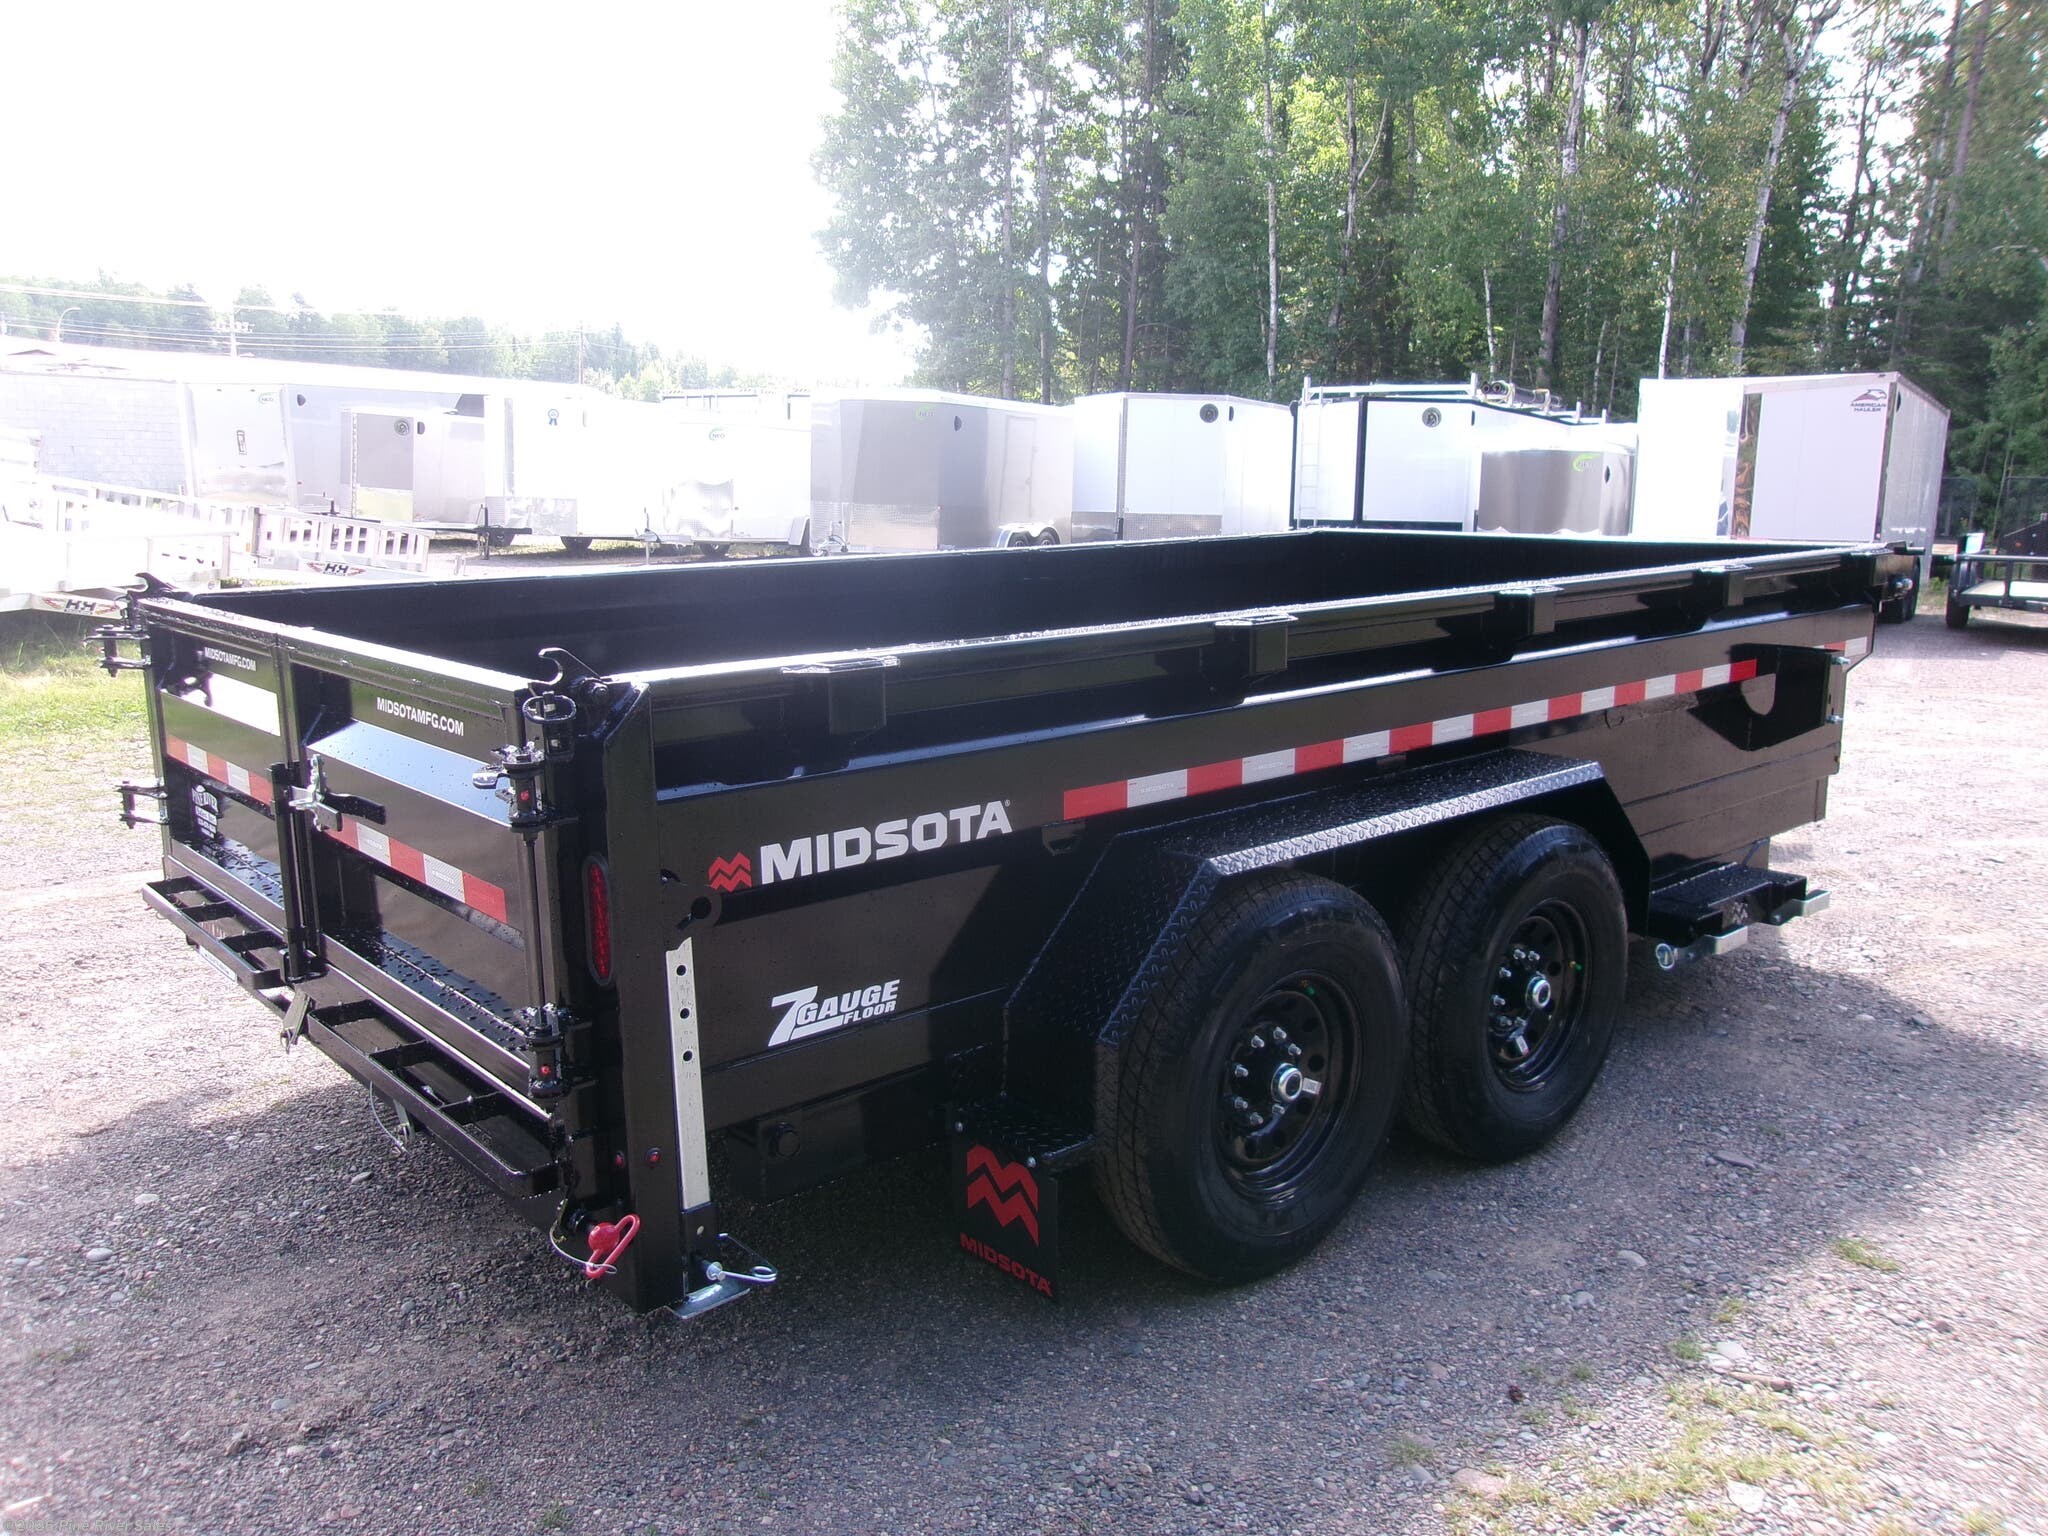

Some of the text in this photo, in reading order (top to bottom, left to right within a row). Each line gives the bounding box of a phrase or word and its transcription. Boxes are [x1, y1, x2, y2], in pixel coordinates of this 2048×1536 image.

[204, 647, 256, 671] MIDSOTAMFG.COM
[376, 697, 464, 736] MIDSOTAMFG.COM
[760, 800, 1013, 885] MIDSOTA
[768, 979, 900, 1047] 7 GAUGE
[843, 1000, 897, 1025] FLOOR
[960, 1232, 1053, 1297] MIDSOTA
